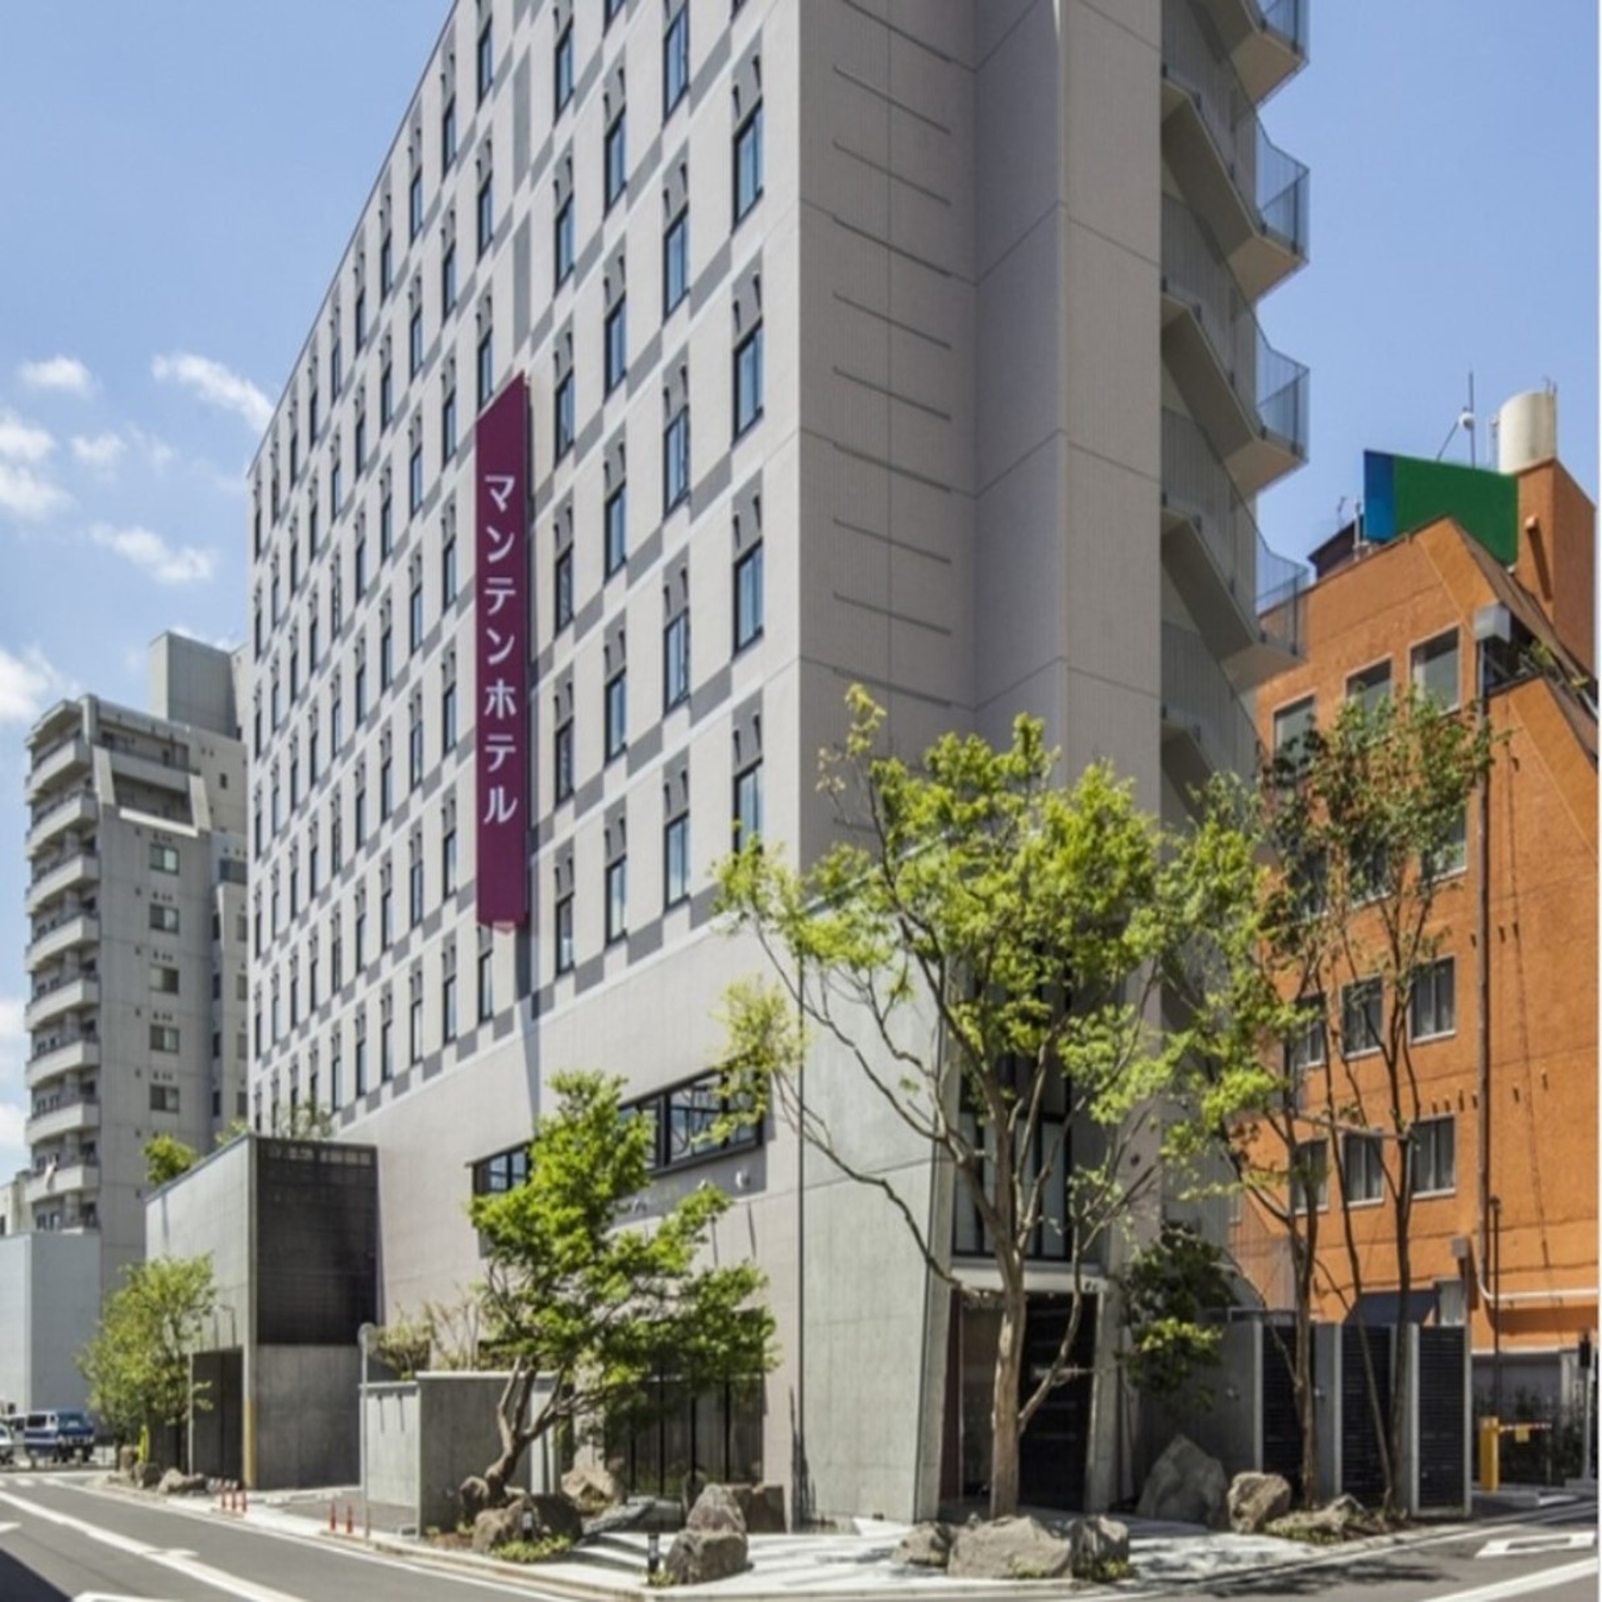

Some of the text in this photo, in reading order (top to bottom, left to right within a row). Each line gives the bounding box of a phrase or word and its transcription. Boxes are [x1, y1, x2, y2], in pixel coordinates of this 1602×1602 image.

[484, 475, 517, 824] マンテンホテル
